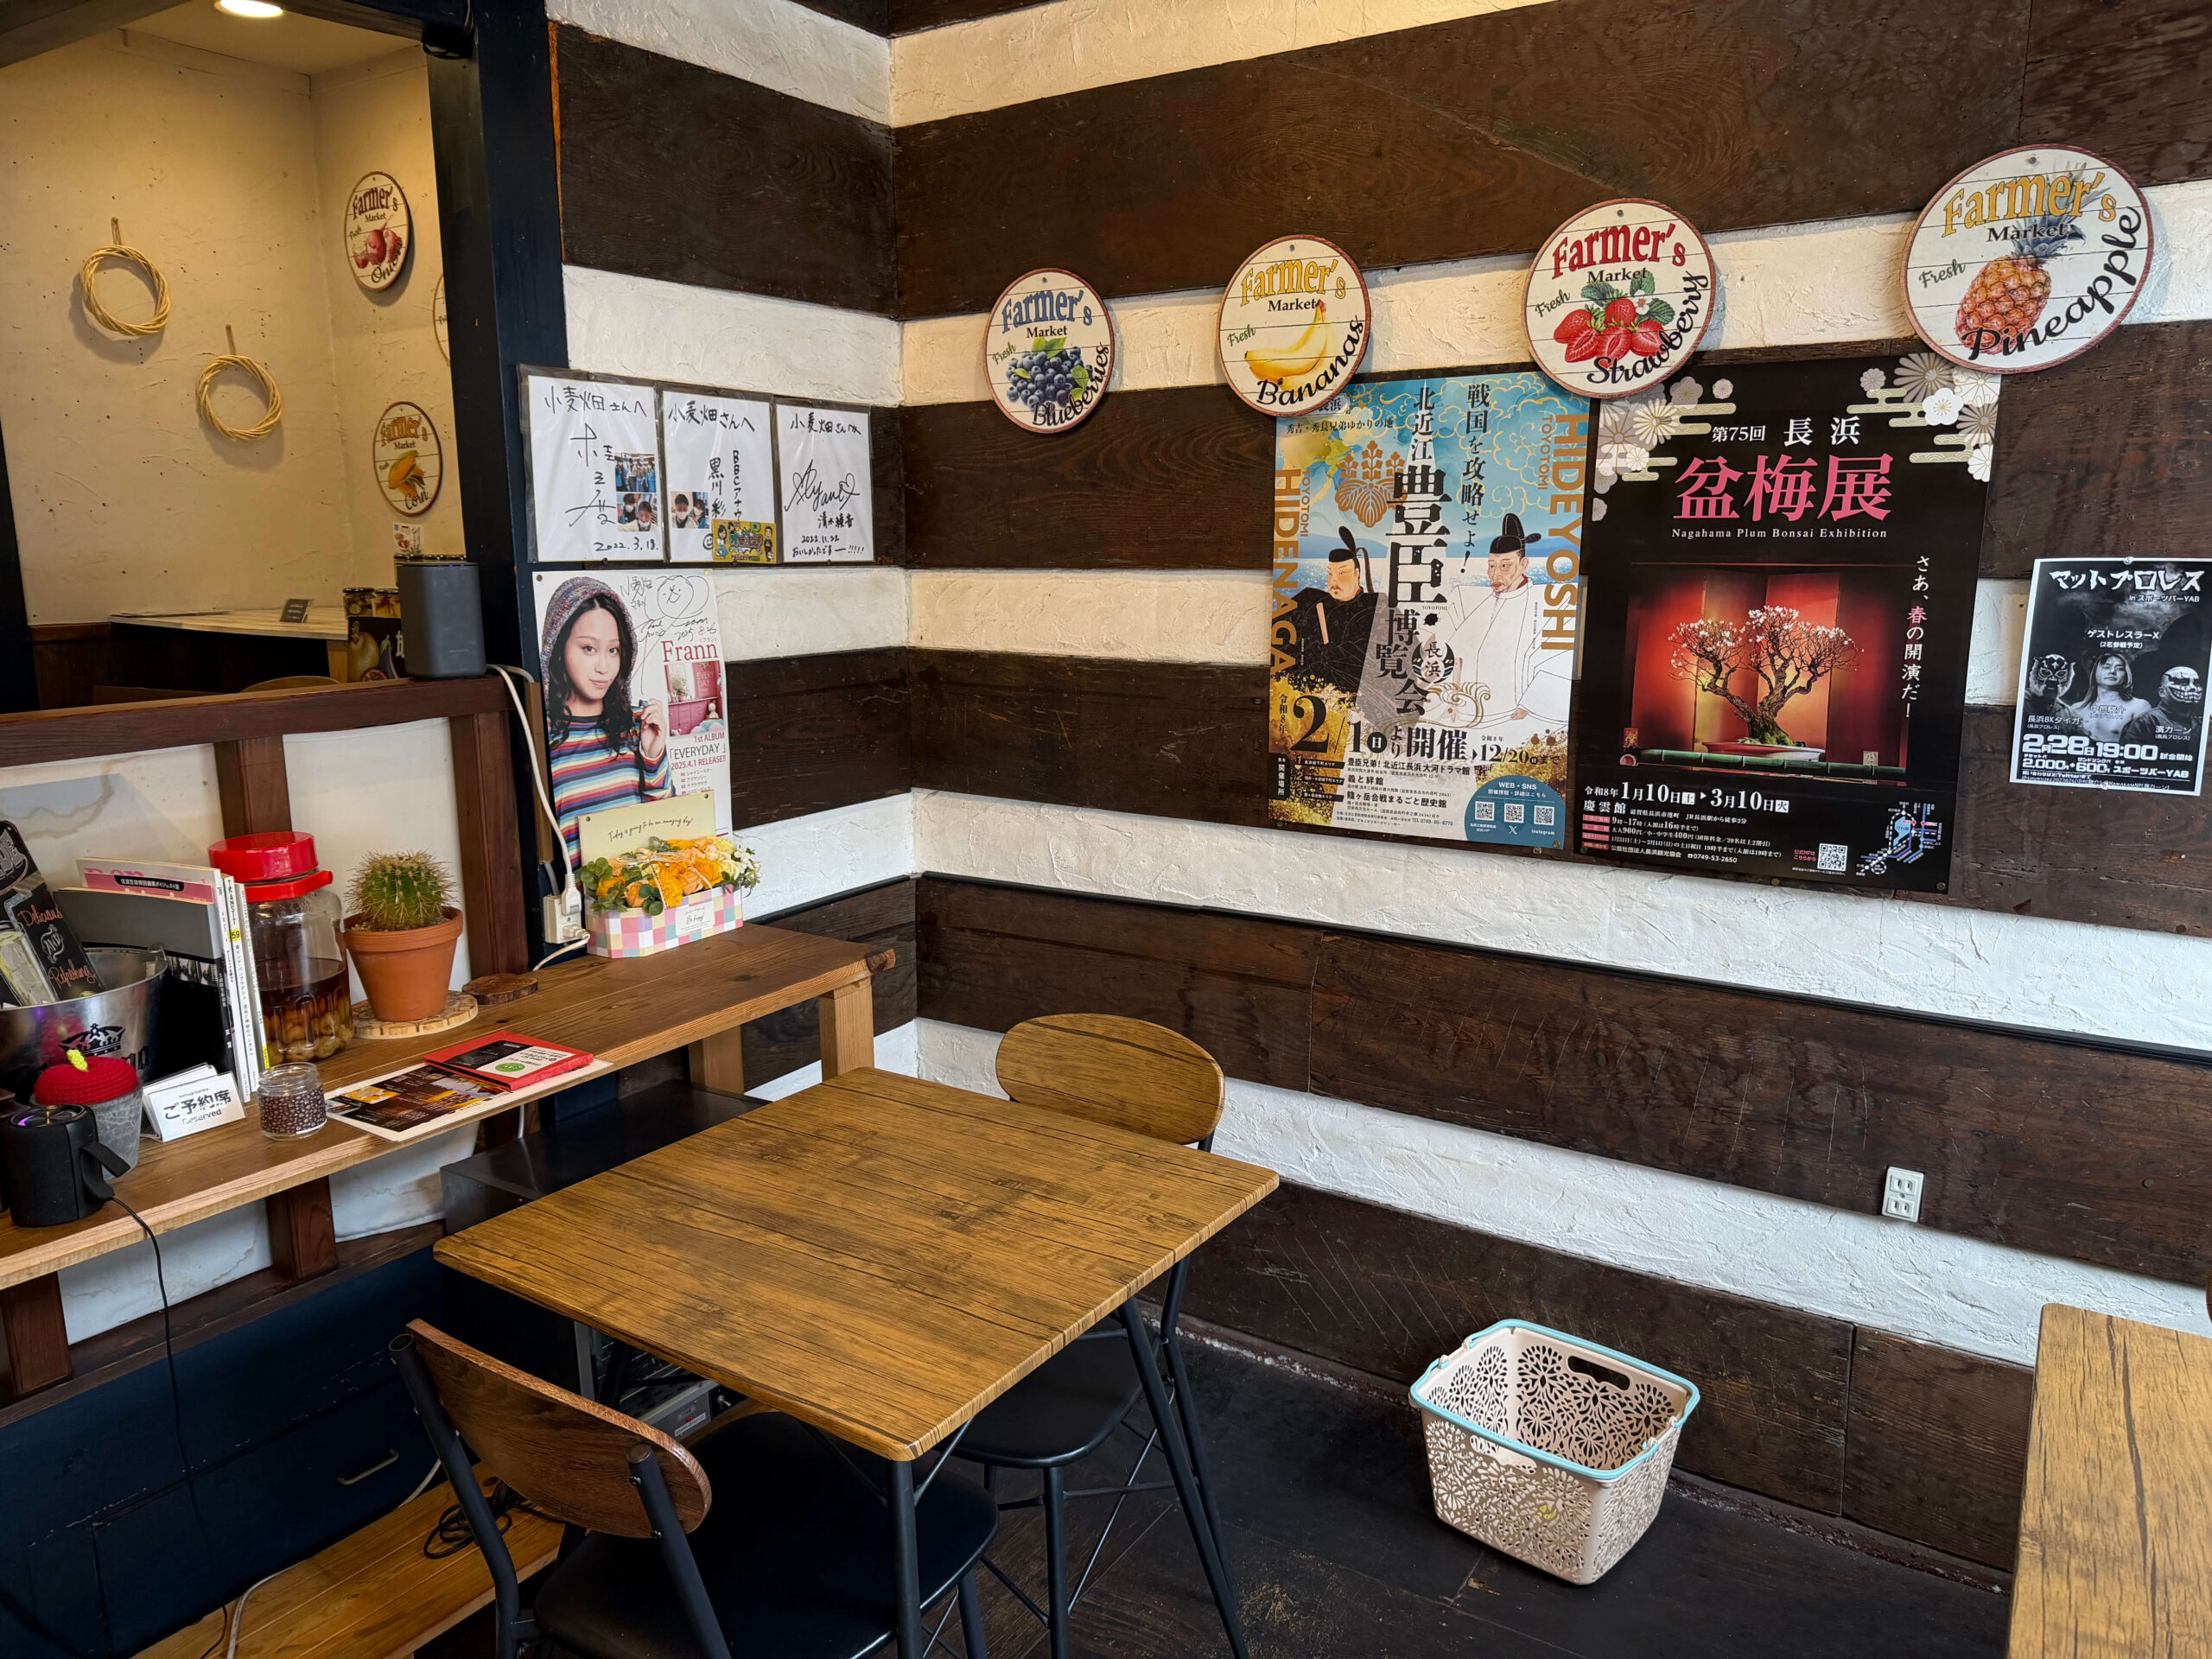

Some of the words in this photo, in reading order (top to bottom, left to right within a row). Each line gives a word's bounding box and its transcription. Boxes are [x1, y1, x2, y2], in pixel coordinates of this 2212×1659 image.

[353, 186, 397, 220] Farmer's
[1942, 172, 2117, 238] Farmer's
[365, 213, 386, 222] Market
[1986, 222, 2068, 242] Market
[1551, 223, 1686, 280] Farmer's
[1240, 259, 1346, 307] Farmer's
[1587, 267, 1649, 283] Market
[1918, 258, 1966, 289] Fresh
[1961, 207, 2142, 360] Pineapple
[1001, 289, 1093, 334] Farmer's
[1268, 298, 1317, 312] Market
[1535, 289, 1571, 318] Fresh
[1027, 325, 1067, 338] Market
[1227, 324, 1256, 347] Fresh
[1586, 270, 1709, 385] Strawberry
[992, 341, 1017, 365] Fresh
[1256, 315, 1363, 406] Bananas
[1032, 341, 1109, 427] Blueberries
[380, 416, 428, 448] Farmer's
[1287, 418, 1395, 435] 秀吉・秀長兄弟ゆかりの地
[1712, 425, 1766, 443] 第75回
[394, 441, 416, 450] Market
[1538, 416, 1554, 490] TOYOTOMI
[405, 490, 429, 511] Corn
[1673, 453, 1895, 522] 盆梅展
[1300, 469, 1311, 537] TOYOTOMI
[1541, 414, 1589, 651] HIDEYOSHI
[1671, 528, 1732, 541] Nagahama
[1736, 528, 1767, 539] Plum
[1771, 528, 1815, 539] Bonsai
[1819, 528, 1888, 539] Exhibition
[1270, 468, 1301, 674] HIDENAGA
[2049, 569, 2205, 591] マットプロレス
[2087, 630, 2160, 640] ゲストレスラーX
[661, 640, 719, 663] Frann
[694, 734, 703, 743] 1st
[704, 732, 725, 742] ALBUM
[1583, 799, 1627, 815] 慶雲館
[18, 905, 63, 926] Delicious
[227, 880, 237, 925] TRANSIT
[231, 931, 241, 940] 59
[163, 1089, 232, 1121] ご予約席
